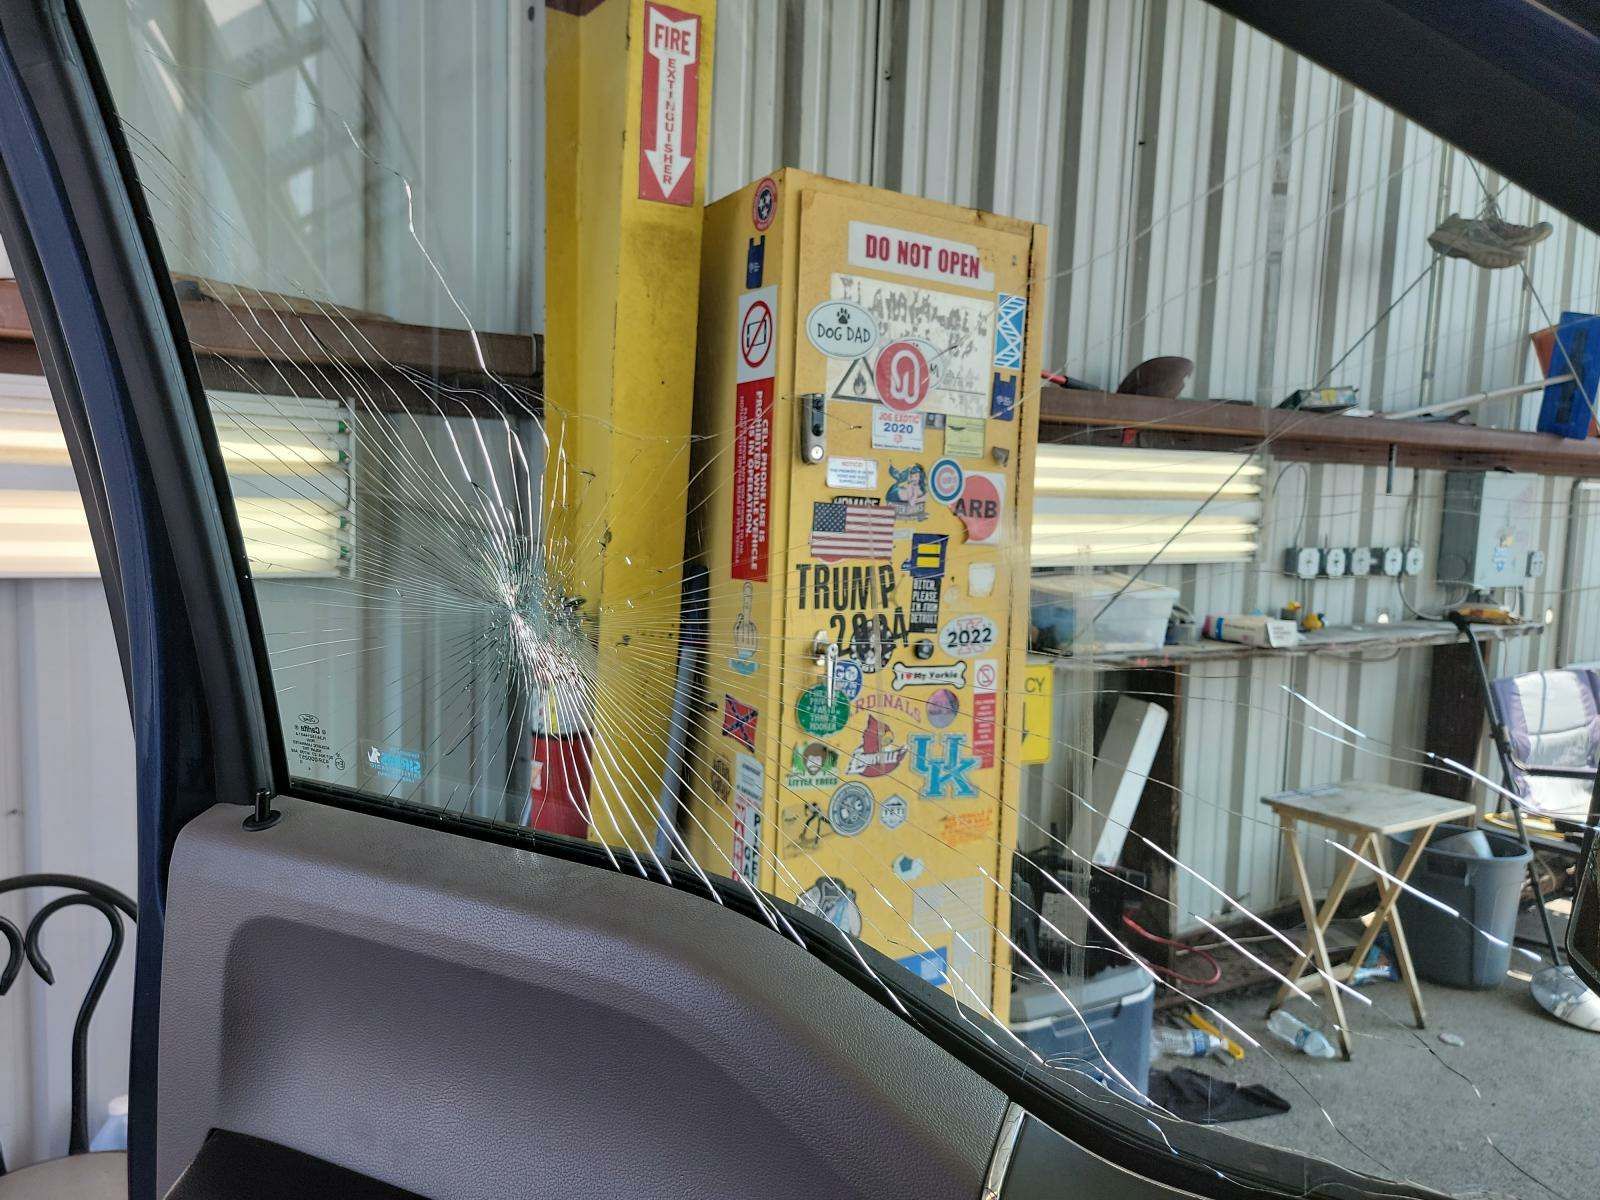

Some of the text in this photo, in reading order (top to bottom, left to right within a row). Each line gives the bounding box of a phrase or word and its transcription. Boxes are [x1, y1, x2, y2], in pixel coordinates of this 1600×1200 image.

[655, 23, 691, 56] FIRE
[663, 58, 677, 185] EXTINGUISHER
[865, 233, 981, 280] DO NOT OPEN
[817, 323, 872, 343] DOG DAD
[883, 422, 914, 434] 2020
[748, 440, 755, 455] IN
[751, 390, 764, 570] PROHIBITED WHILE VEHICLE
[758, 418, 769, 543] CELL PHONE USE IS
[955, 498, 998, 519] ARB
[796, 564, 896, 611] TRUMP
[947, 628, 993, 648] 2022
[913, 672, 927, 682] My
[929, 671, 959, 681] Yorkie
[851, 695, 921, 723] RDINALS
[910, 733, 980, 799] UK
[814, 777, 838, 787] TREES
